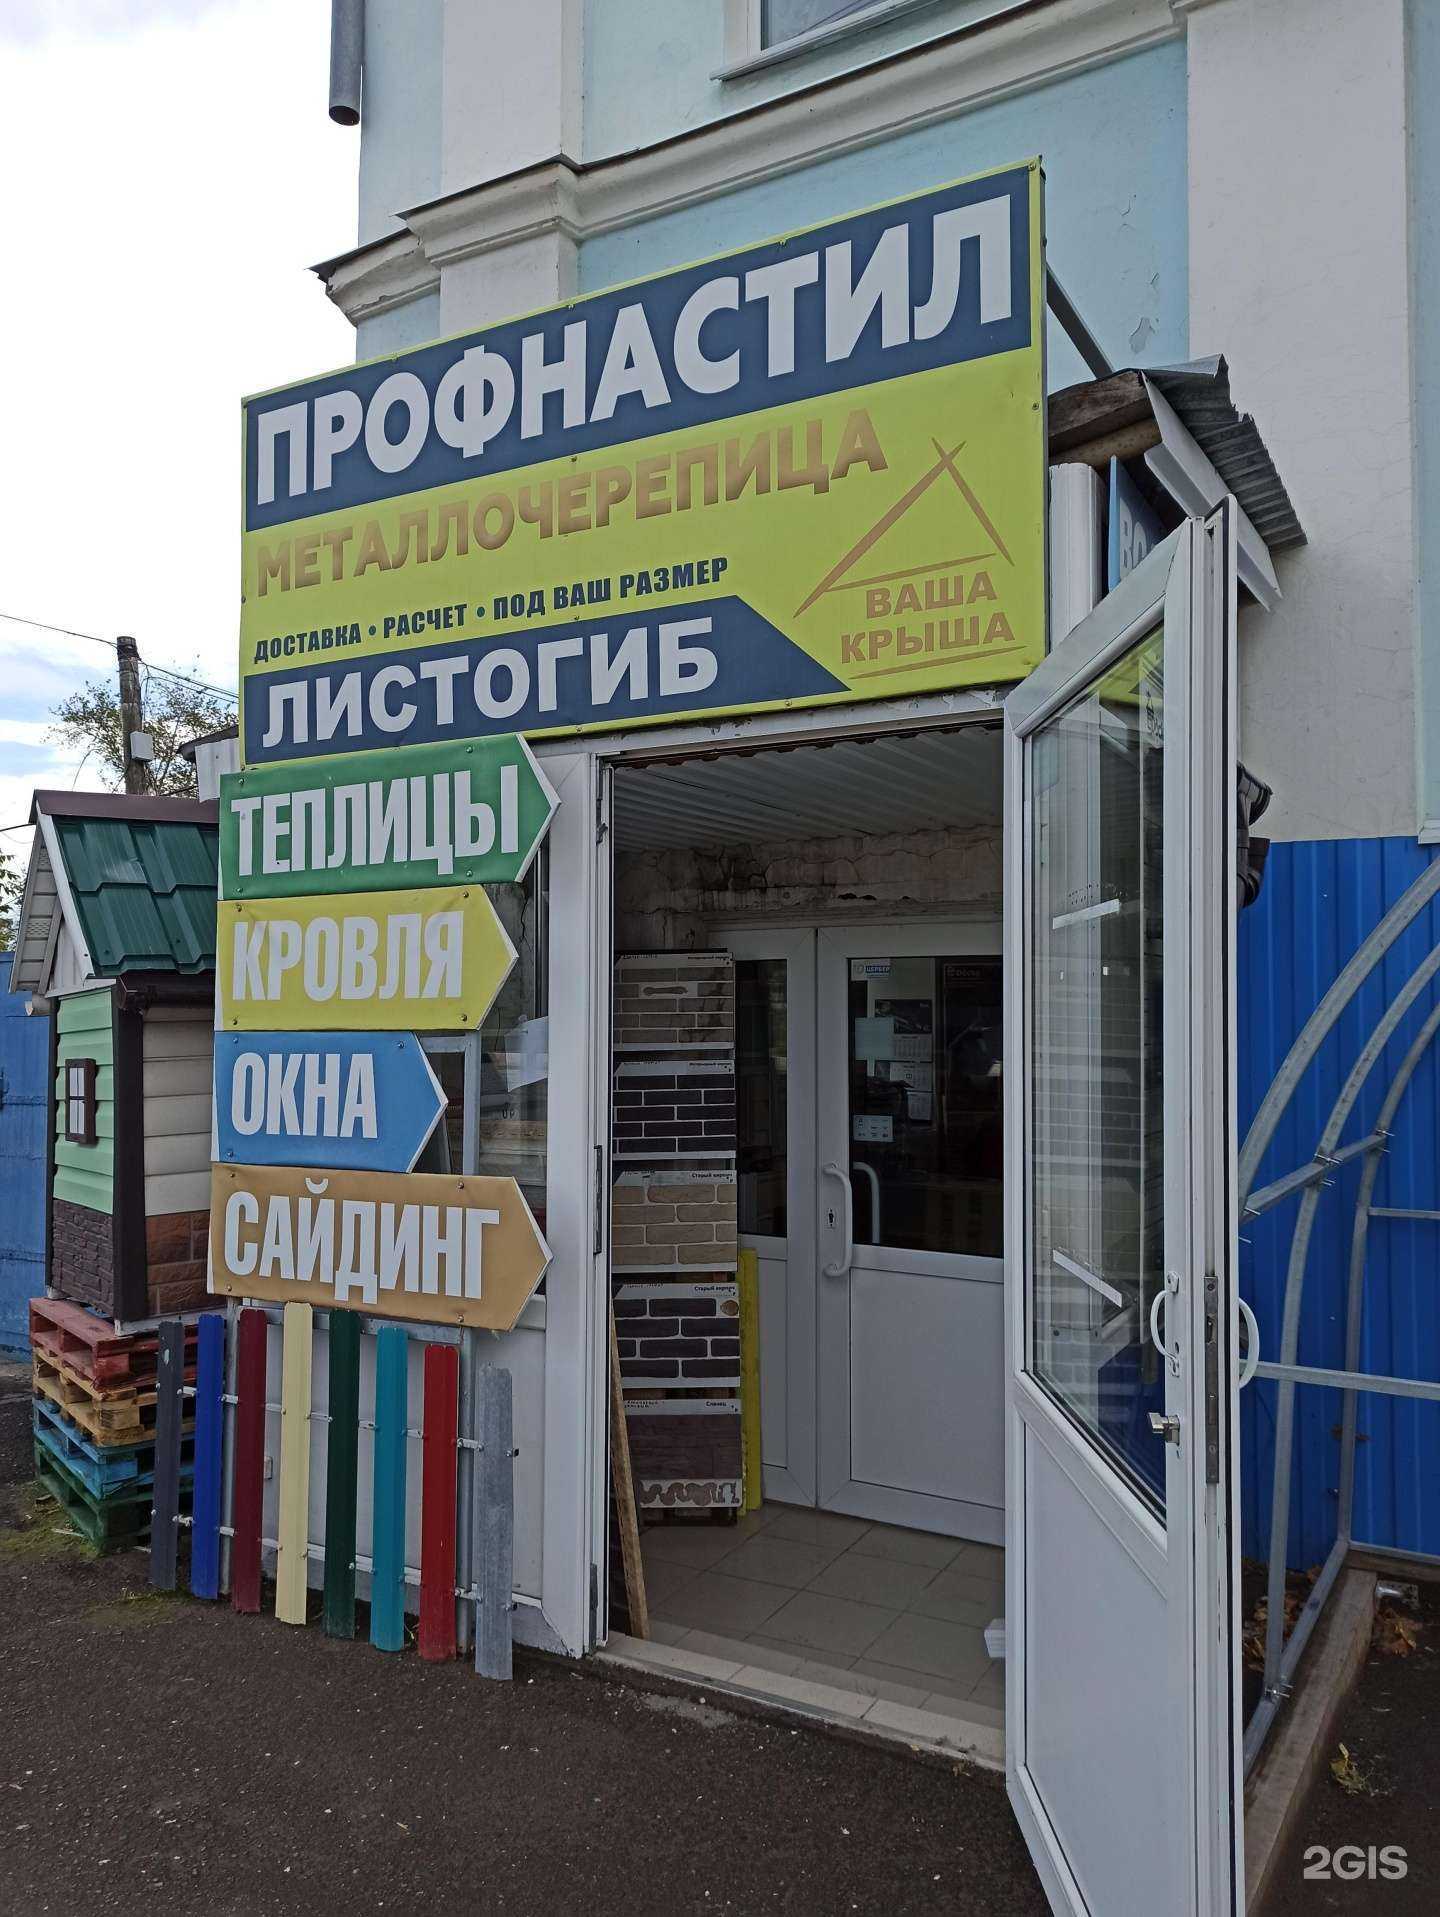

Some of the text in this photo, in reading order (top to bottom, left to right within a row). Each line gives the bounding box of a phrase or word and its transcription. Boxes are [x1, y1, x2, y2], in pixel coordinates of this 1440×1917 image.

[257, 194, 1012, 505] ПРОФНАСТИЛ
[257, 407, 889, 597] МЕТАЛЛОЧЕРЕПИЦА
[254, 557, 729, 665] ДОСТАВКА РАСЧЕТ ПОД ВАШ РАЗМЕР
[840, 612, 1016, 664] КРЫША
[866, 571, 998, 619] ВАША
[262, 616, 718, 748] ЛИСТОГИБ
[231, 764, 519, 876] ТЕПЛИЦЫ
[232, 911, 464, 1002] КРОВЛЯ
[231, 1052, 378, 1139] ОКНА
[224, 1177, 499, 1305] САЙДИНГ
